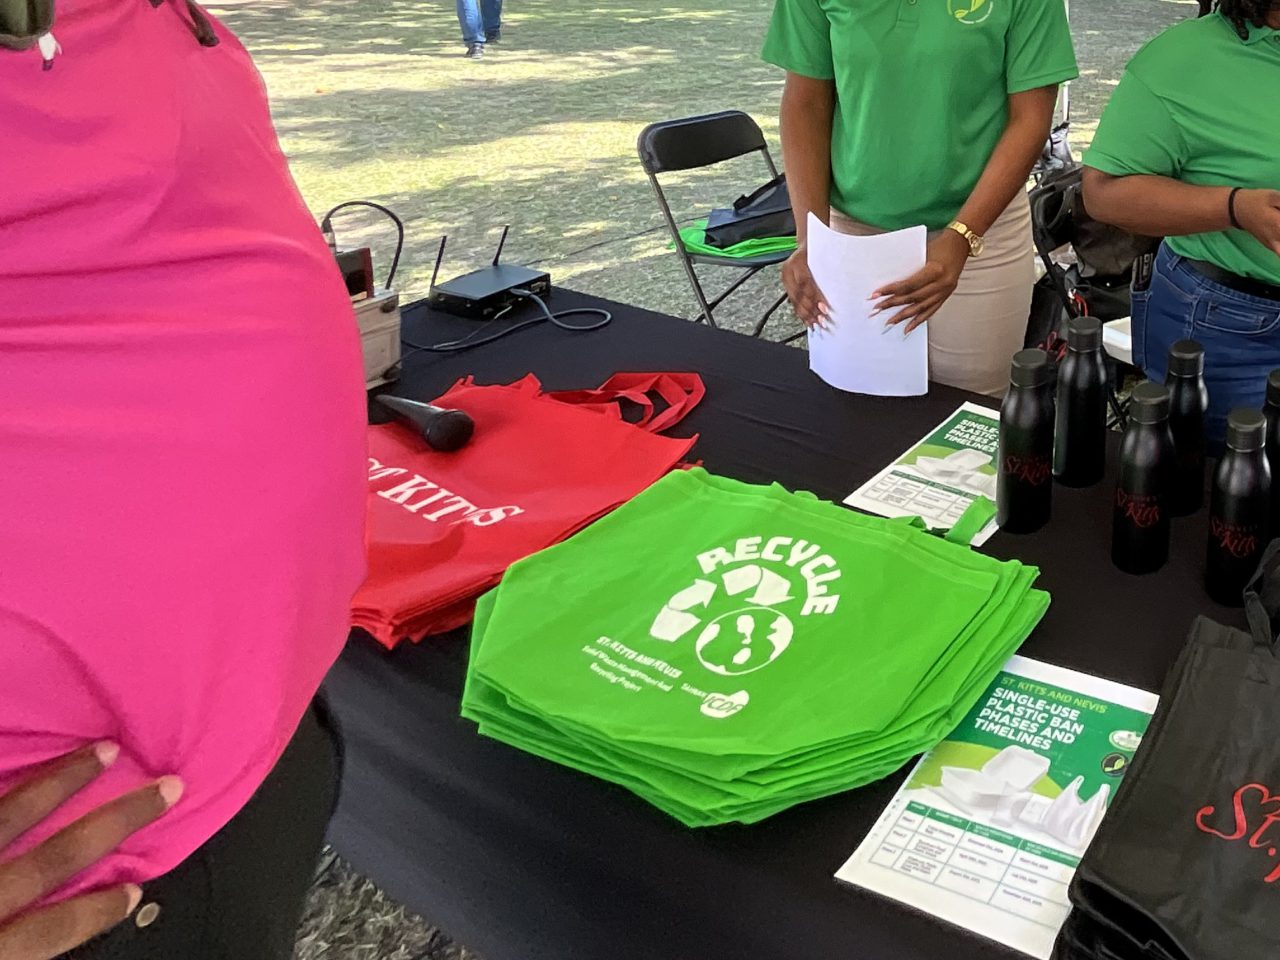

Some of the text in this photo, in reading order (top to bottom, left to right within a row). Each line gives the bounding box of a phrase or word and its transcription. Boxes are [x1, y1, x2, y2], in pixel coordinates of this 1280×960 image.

[696, 536, 842, 616] RECYCLE
[703, 695, 744, 714] ICDF
[993, 687, 1081, 721] SINGLE-USE
[1017, 681, 1046, 697] KITTS
[1048, 690, 1073, 703] AND
[1072, 696, 1108, 715] NEVIS
[979, 708, 1076, 745] PHASES AND
[986, 697, 1084, 735] PLASTIC BAN
[974, 718, 1053, 751] TIMELINES
